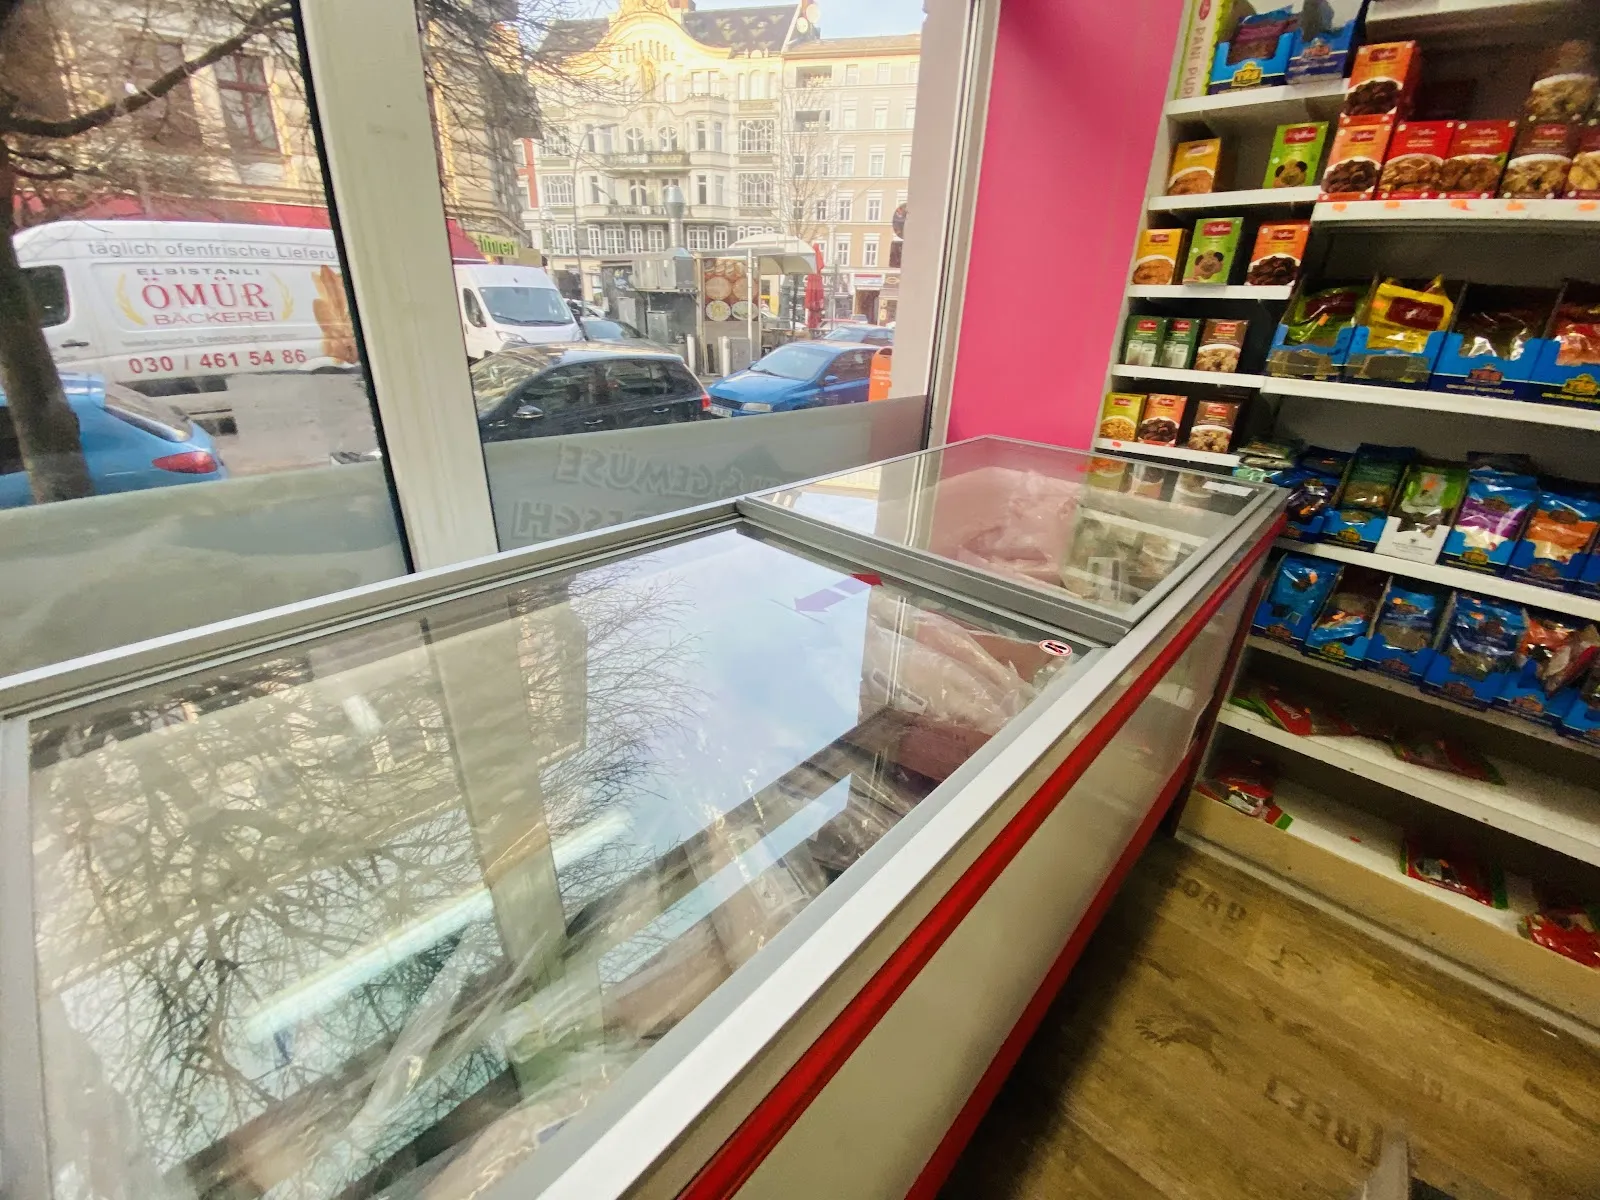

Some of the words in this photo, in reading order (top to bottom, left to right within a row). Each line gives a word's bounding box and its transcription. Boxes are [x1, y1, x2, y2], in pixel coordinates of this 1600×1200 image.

[88, 241, 157, 258] täglich
[164, 242, 271, 258] ofenfrische
[276, 246, 337, 260] Lieferu
[142, 276, 272, 310] ÖMÜR
[128, 355, 174, 374] 030
[200, 352, 239, 369] 461
[250, 349, 275, 366] 54
[282, 349, 307, 364] 86
